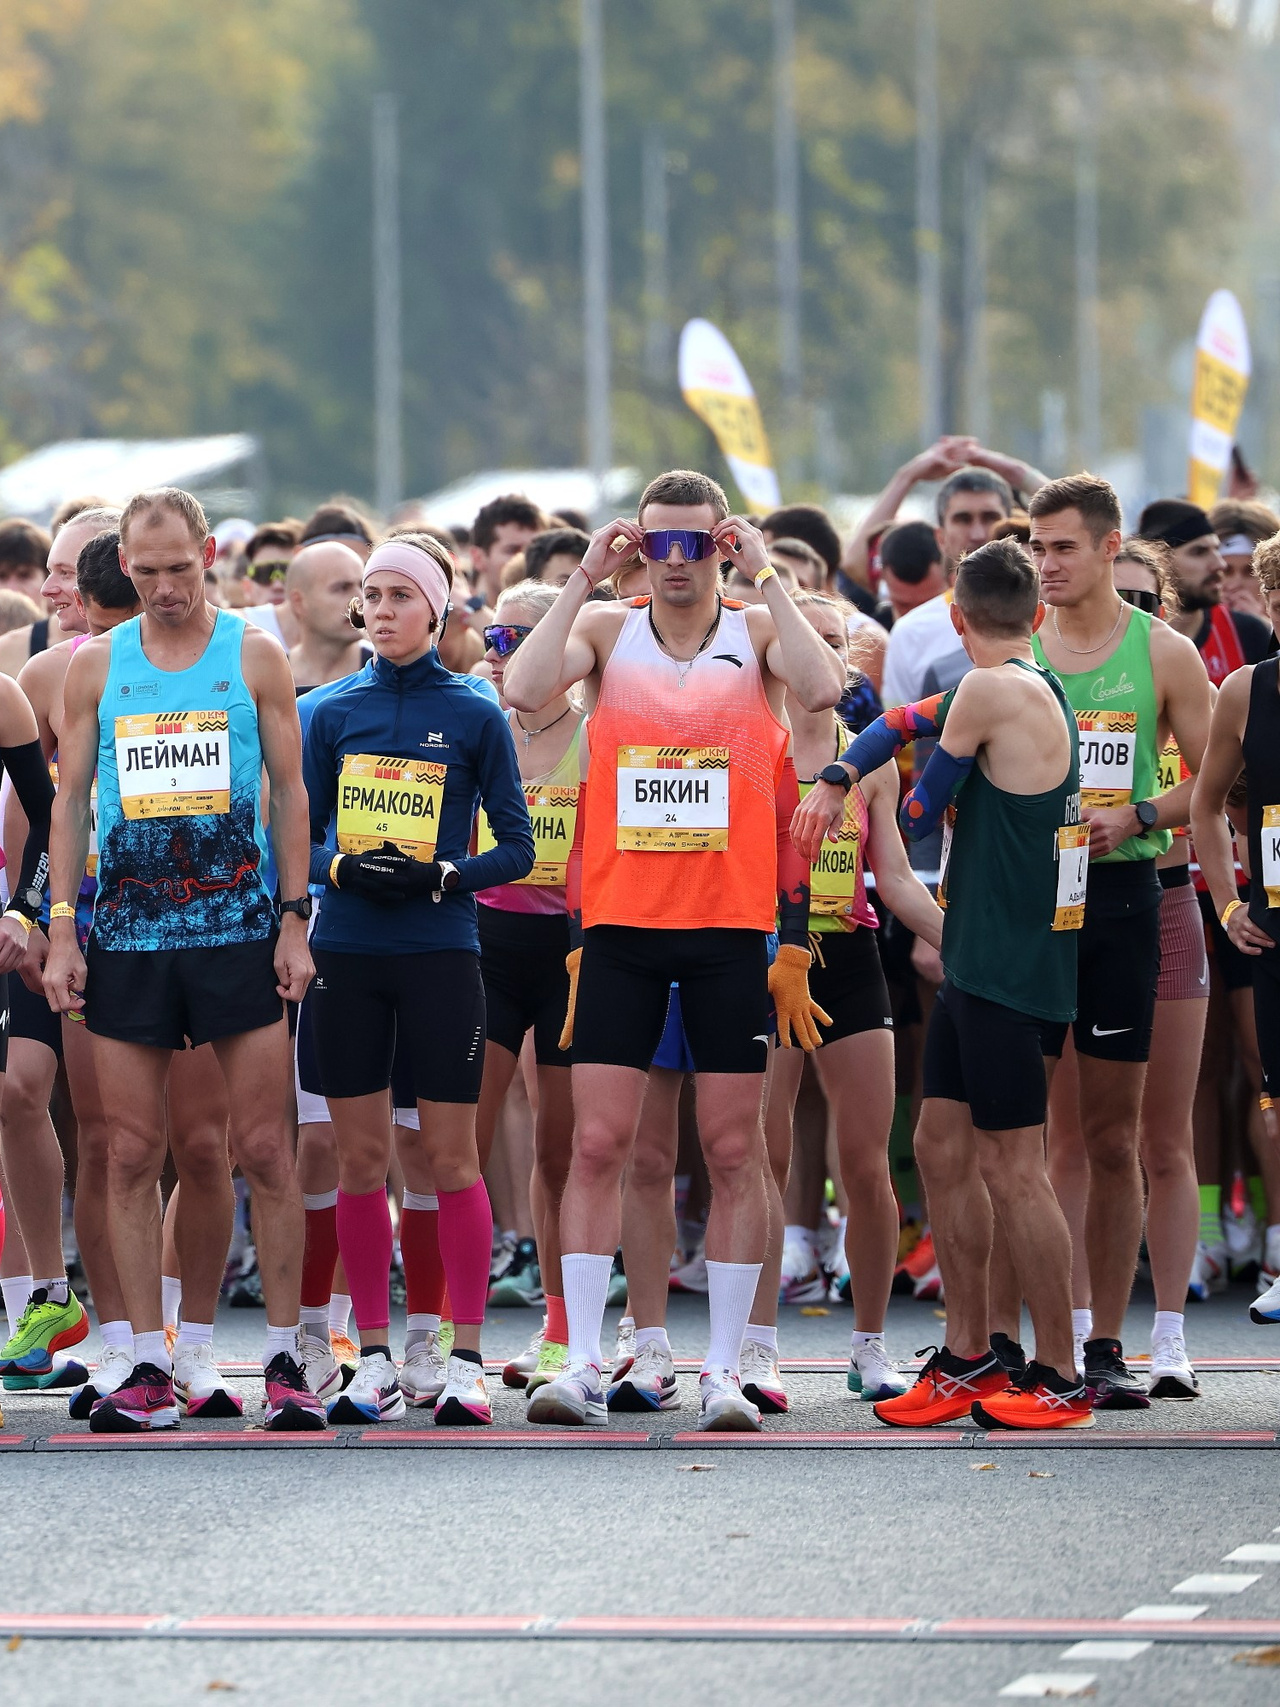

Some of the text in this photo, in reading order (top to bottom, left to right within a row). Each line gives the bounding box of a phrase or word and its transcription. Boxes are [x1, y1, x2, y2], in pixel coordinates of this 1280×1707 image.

[126, 740, 220, 772] ЛЕЙМАН
[171, 778, 177, 787] 3
[635, 779, 709, 803] БЯКИН
[343, 786, 435, 819] ЕРМАКОВА
[665, 814, 677, 823] 24
[376, 823, 388, 832] 45
[359, 862, 395, 874] NORDSKI
